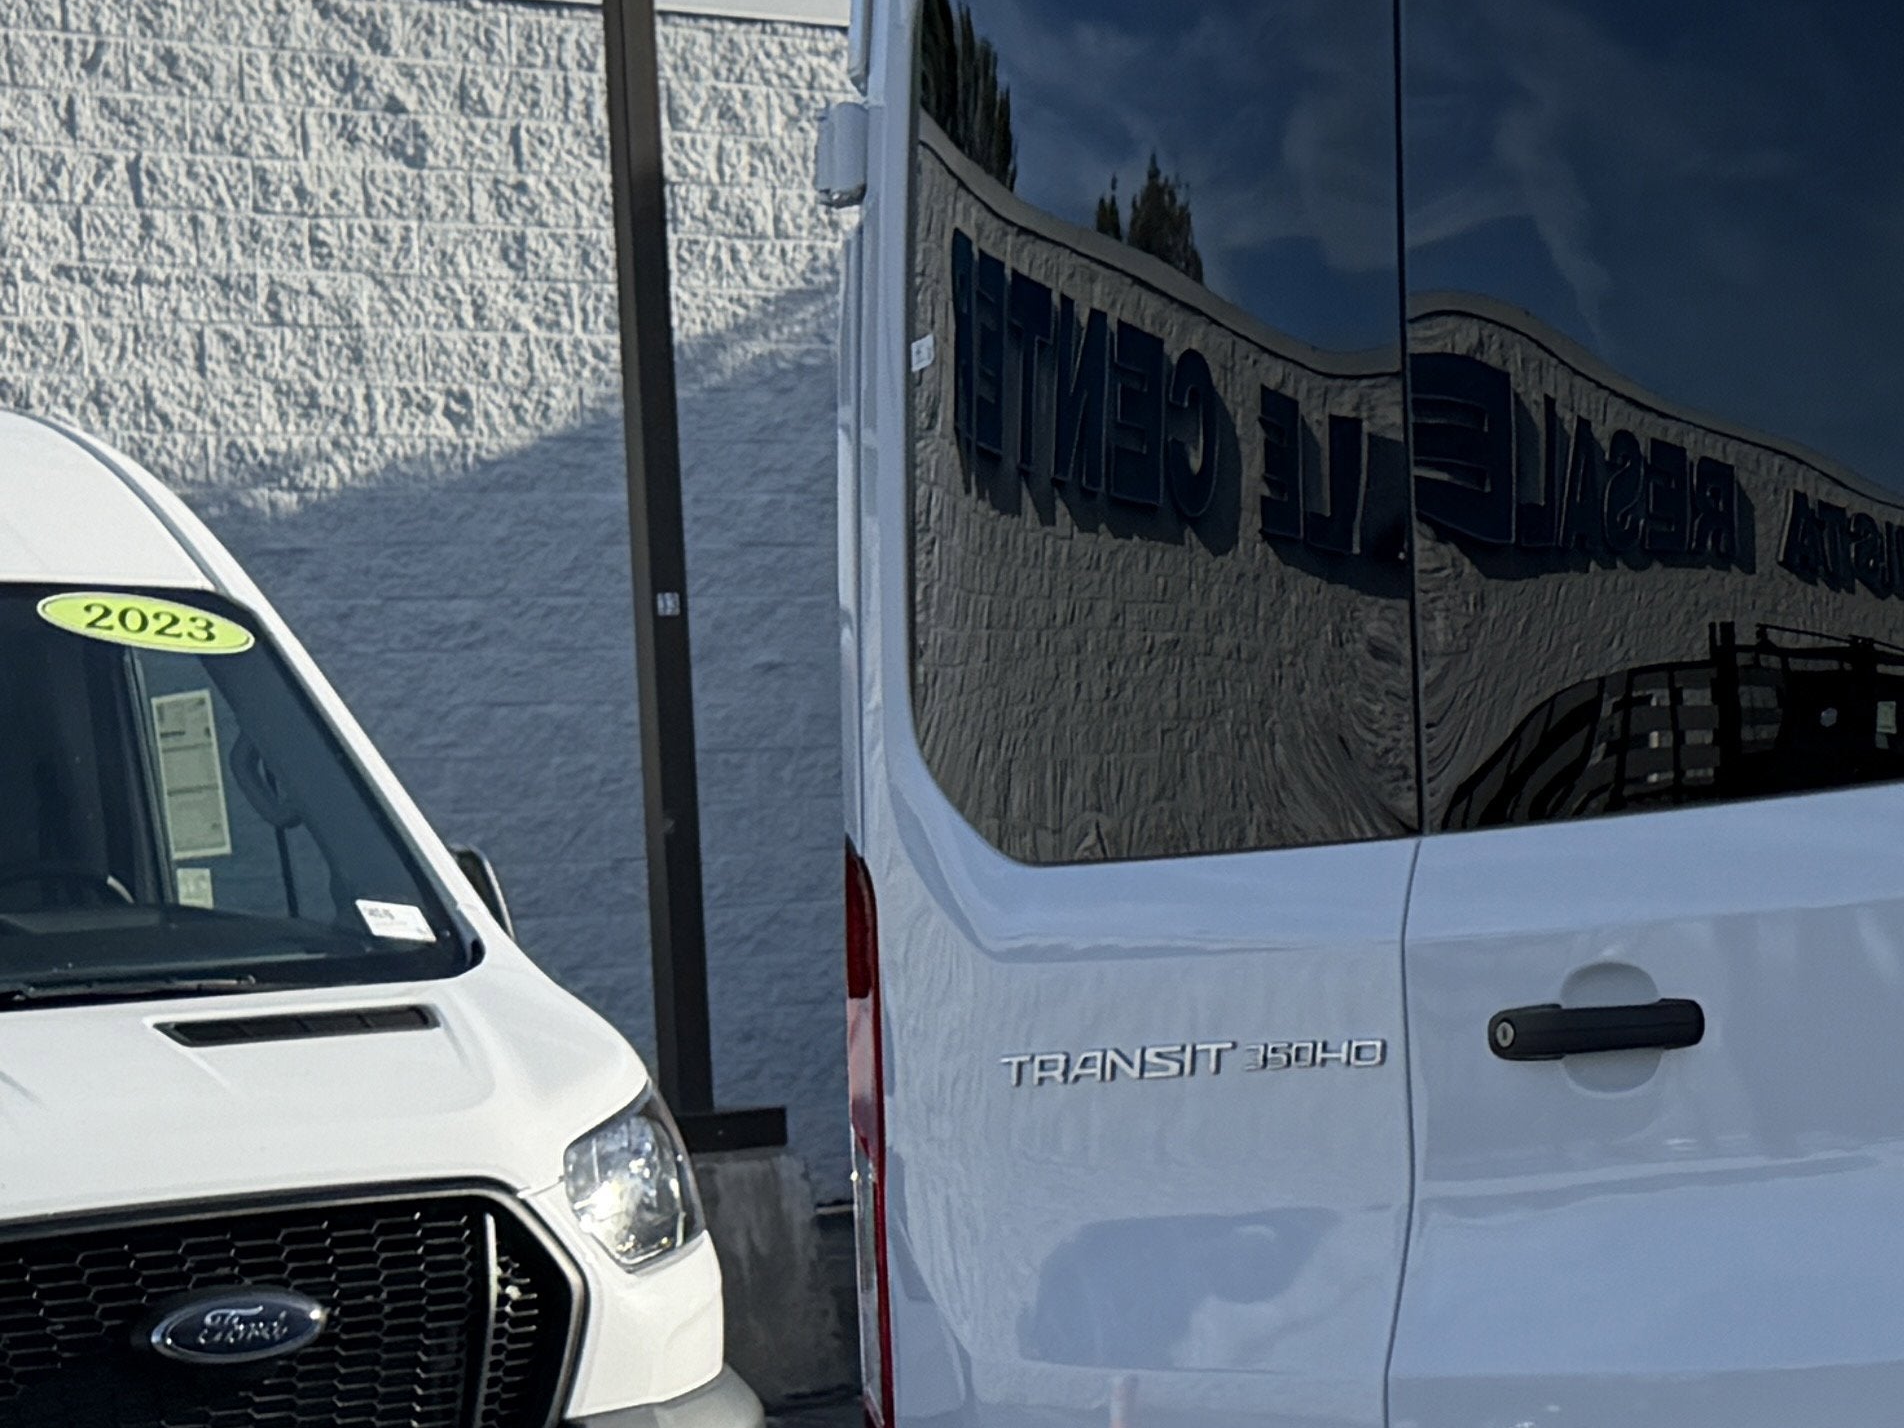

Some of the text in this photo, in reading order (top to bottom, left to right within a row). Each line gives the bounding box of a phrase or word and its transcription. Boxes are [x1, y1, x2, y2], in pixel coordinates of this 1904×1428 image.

[83, 603, 216, 642] 2023
[1000, 1038, 1387, 1086] TRANSIT 350HD
